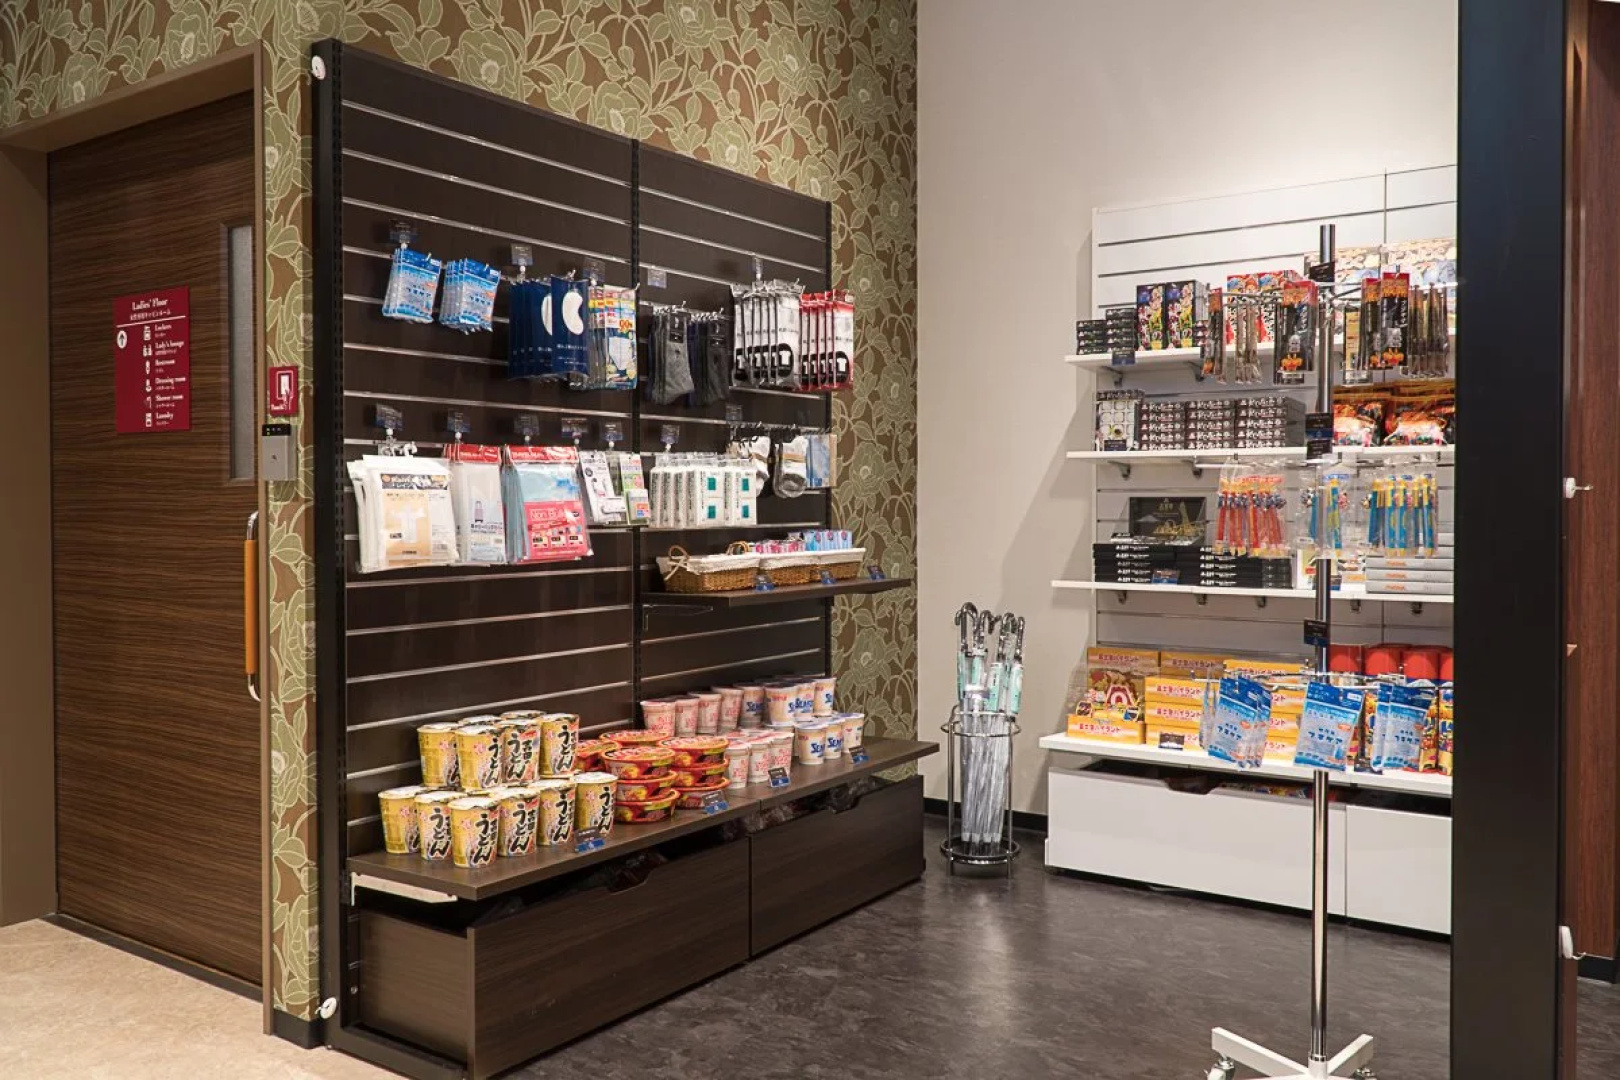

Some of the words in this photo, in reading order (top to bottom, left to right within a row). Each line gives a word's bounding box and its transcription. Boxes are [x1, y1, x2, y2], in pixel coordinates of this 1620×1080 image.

[430, 807, 451, 857] うどん
[473, 813, 492, 865] うどん
[510, 802, 530, 852] うどん
